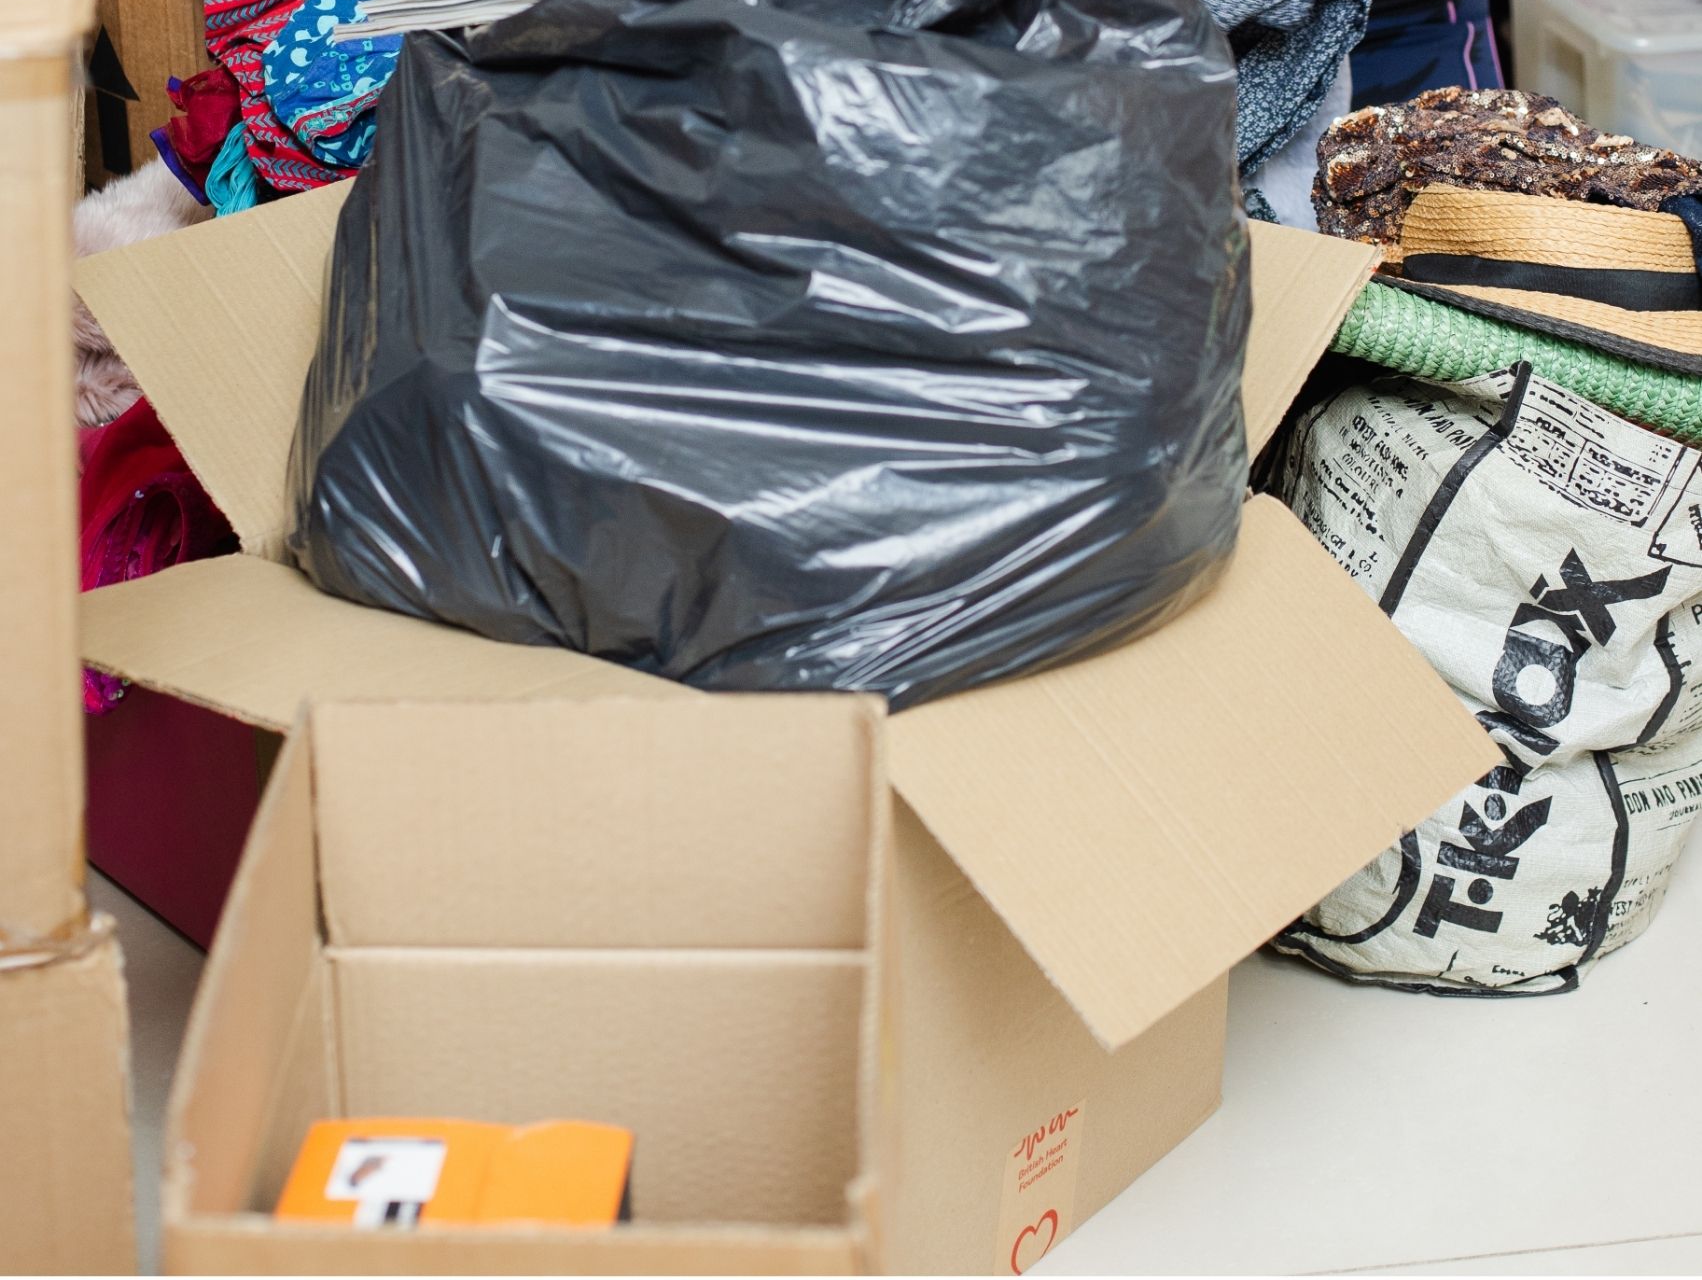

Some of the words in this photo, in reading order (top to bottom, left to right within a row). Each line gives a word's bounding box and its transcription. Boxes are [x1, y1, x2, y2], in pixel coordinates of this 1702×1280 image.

[1018, 1156, 1044, 1181] British
[1045, 1138, 1068, 1161] Heart
[1018, 1155, 1064, 1193] Foundation
